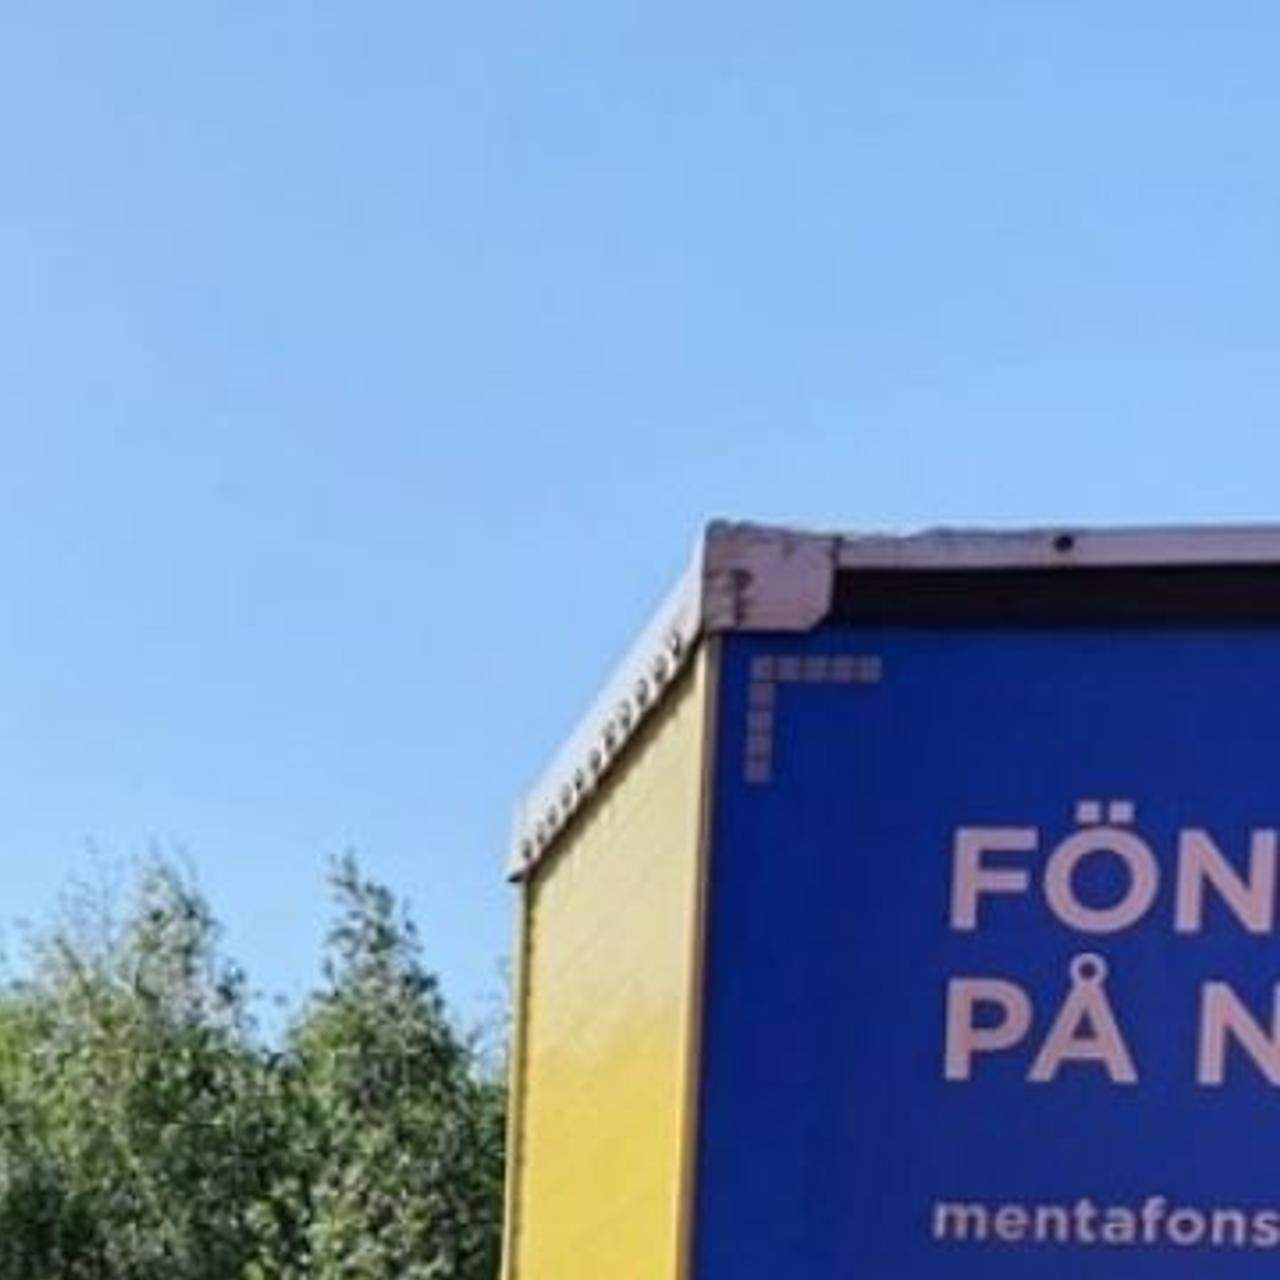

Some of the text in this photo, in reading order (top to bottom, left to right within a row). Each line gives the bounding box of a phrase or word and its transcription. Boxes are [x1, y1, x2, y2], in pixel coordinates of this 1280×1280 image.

[950, 798, 1280, 935] FÖN
[943, 952, 1280, 1088] PÅ N
[932, 1195, 1280, 1249] mentafons
